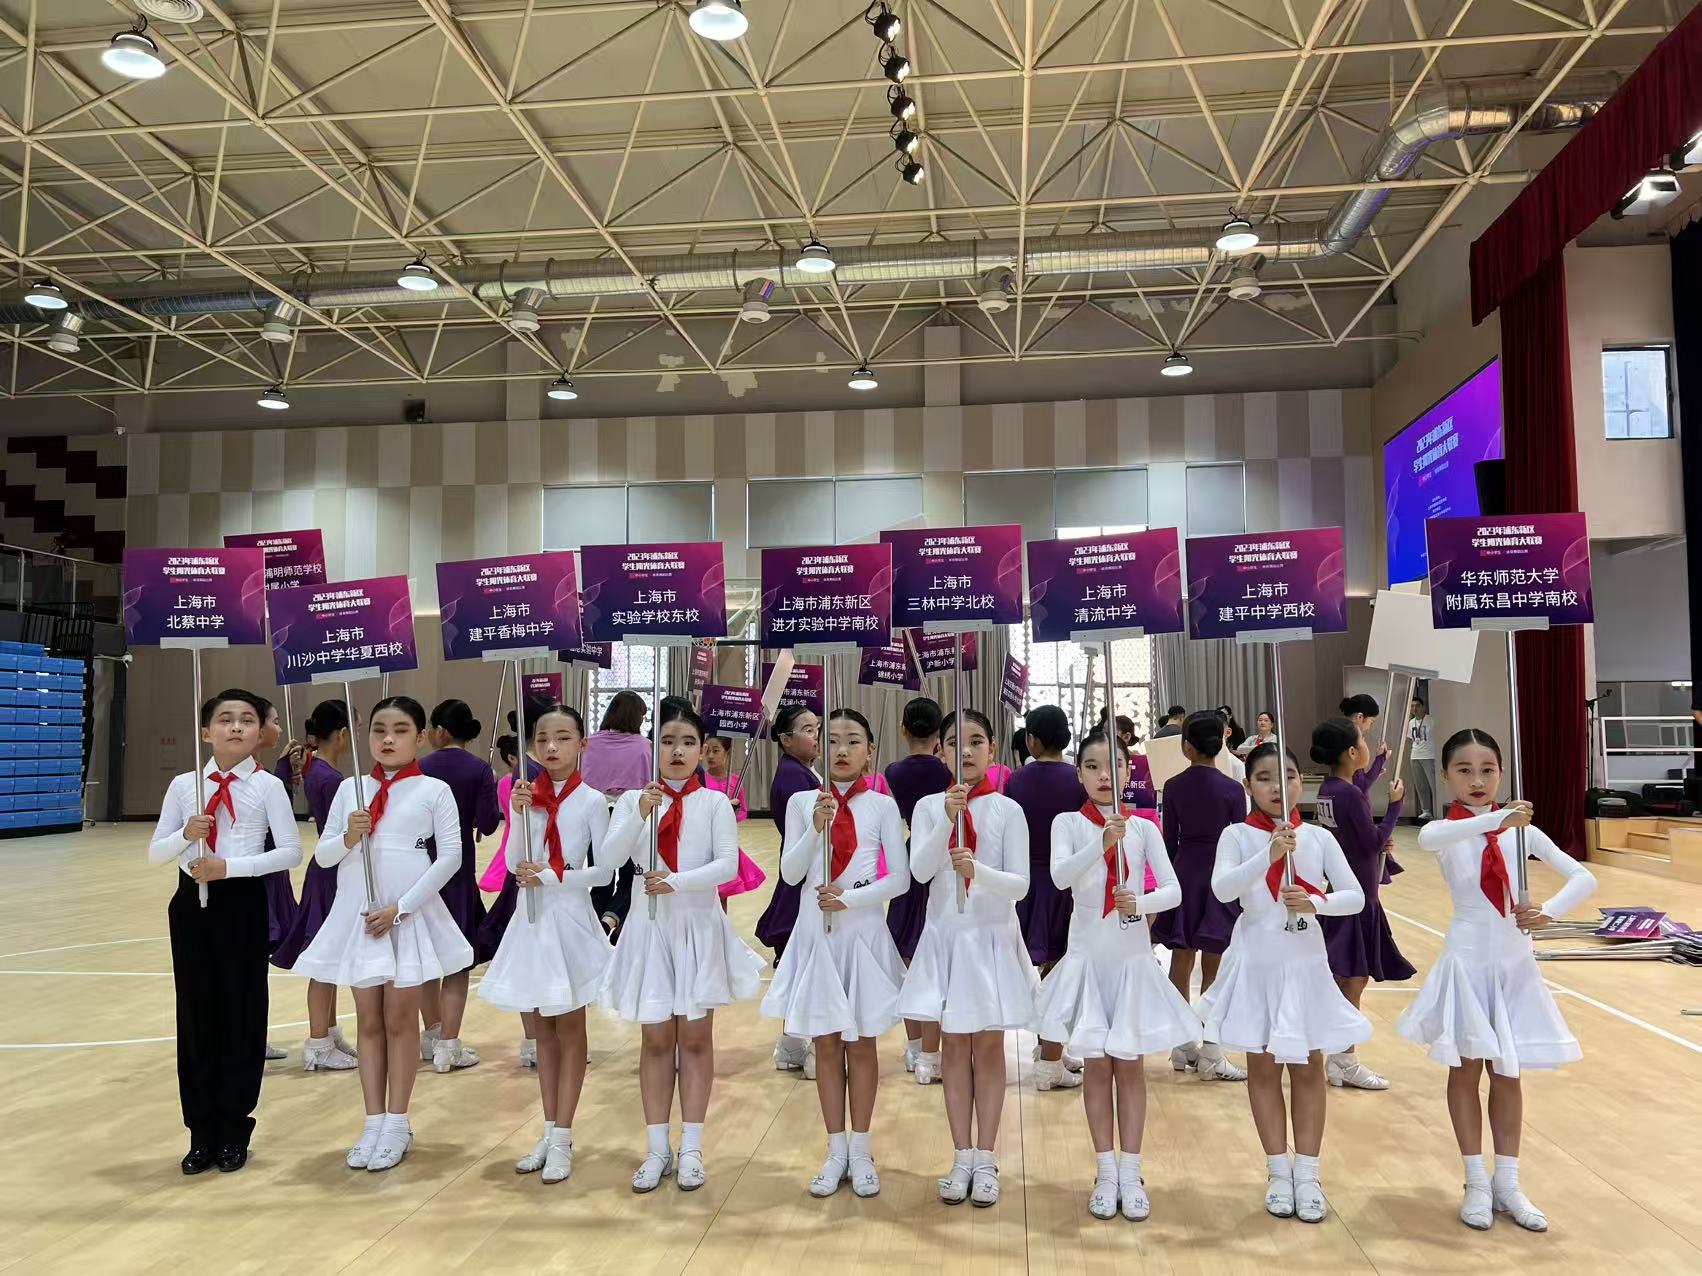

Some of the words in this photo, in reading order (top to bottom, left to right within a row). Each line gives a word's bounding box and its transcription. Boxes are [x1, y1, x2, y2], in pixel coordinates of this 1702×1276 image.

[1476, 524, 1536, 536] 2023年浦东新区
[1234, 540, 1291, 553] 2023年浦东新区
[928, 574, 973, 590] 上海市
[1460, 567, 1560, 587] 华东师范大学
[633, 589, 677, 604] 上海市
[1081, 583, 1128, 601] 上海市
[1241, 581, 1289, 599] 上海市
[173, 595, 217, 609] 上海市
[778, 594, 872, 611] 上海市浦东新区
[907, 594, 995, 611] 三林中学北校
[1446, 590, 1579, 611] 附属东昌中学南校
[488, 602, 531, 620] 上海市
[612, 608, 701, 625] 实验学校东校
[1074, 604, 1137, 623] 清流中学
[1218, 601, 1316, 622] 建平中学西校
[166, 615, 225, 630] 北蔡中学
[468, 620, 555, 643] 建平香梅中学
[771, 614, 880, 632] 进才实验中学南校
[321, 626, 365, 645] 上海市
[287, 641, 404, 669] 川沙中学华夏西校
